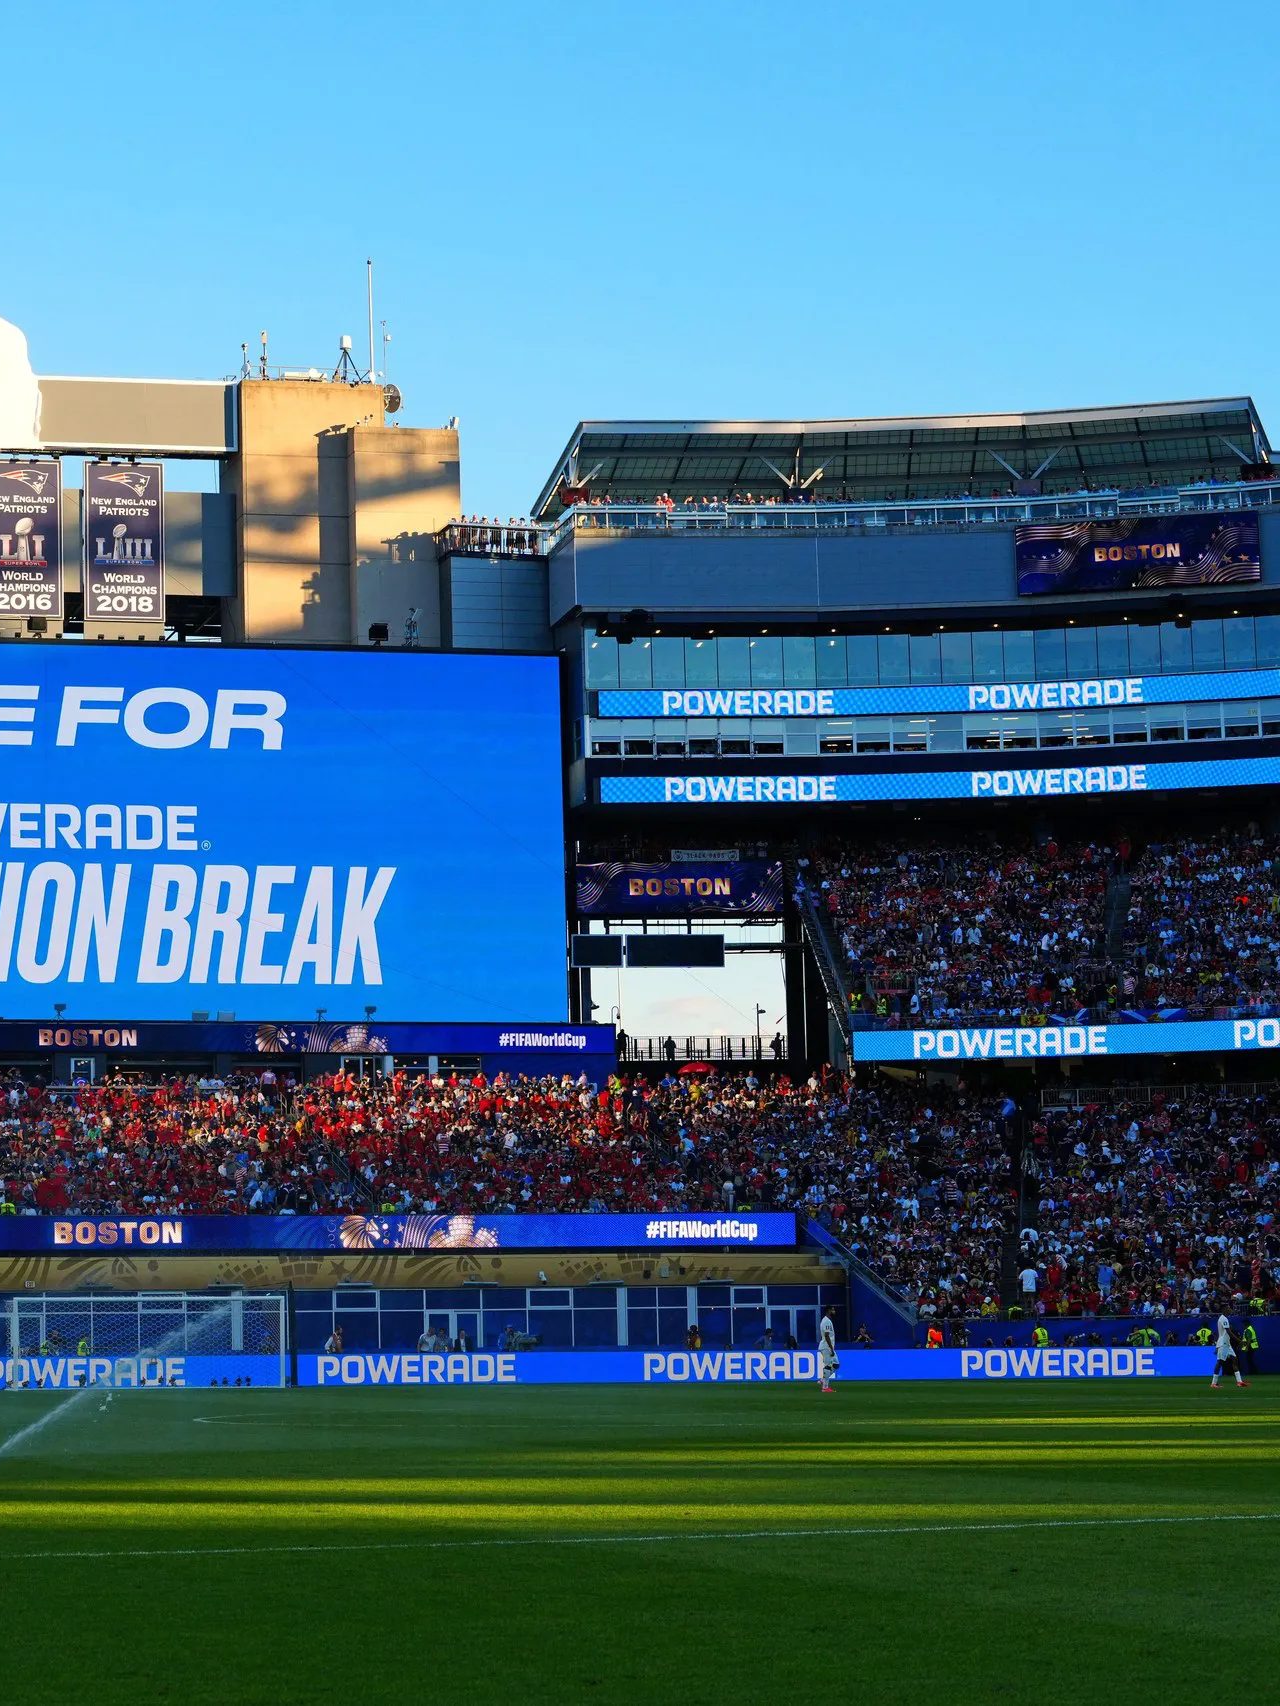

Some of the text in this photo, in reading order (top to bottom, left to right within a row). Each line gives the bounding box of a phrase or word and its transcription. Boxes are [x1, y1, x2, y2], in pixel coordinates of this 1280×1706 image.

[1094, 543, 1181, 562] BOSTON
[96, 596, 154, 613] 2018
[663, 690, 834, 715] POWERADE
[968, 678, 1143, 710] POWERADE
[56, 686, 288, 752] FOR
[665, 776, 837, 801] POWERADE
[971, 765, 1147, 796] POWERADE
[629, 878, 731, 896] BOSTON
[136, 863, 398, 986] BREAK
[38, 1028, 138, 1047] BOSTON
[498, 1030, 588, 1050] #FIFAWorldCup
[914, 1026, 1108, 1058] POWERADE
[54, 1220, 183, 1244] BOSTON
[646, 1220, 759, 1242] #FIFAWorldCup
[317, 1354, 517, 1384] POWERADE
[960, 1348, 1156, 1376] POWERADE
